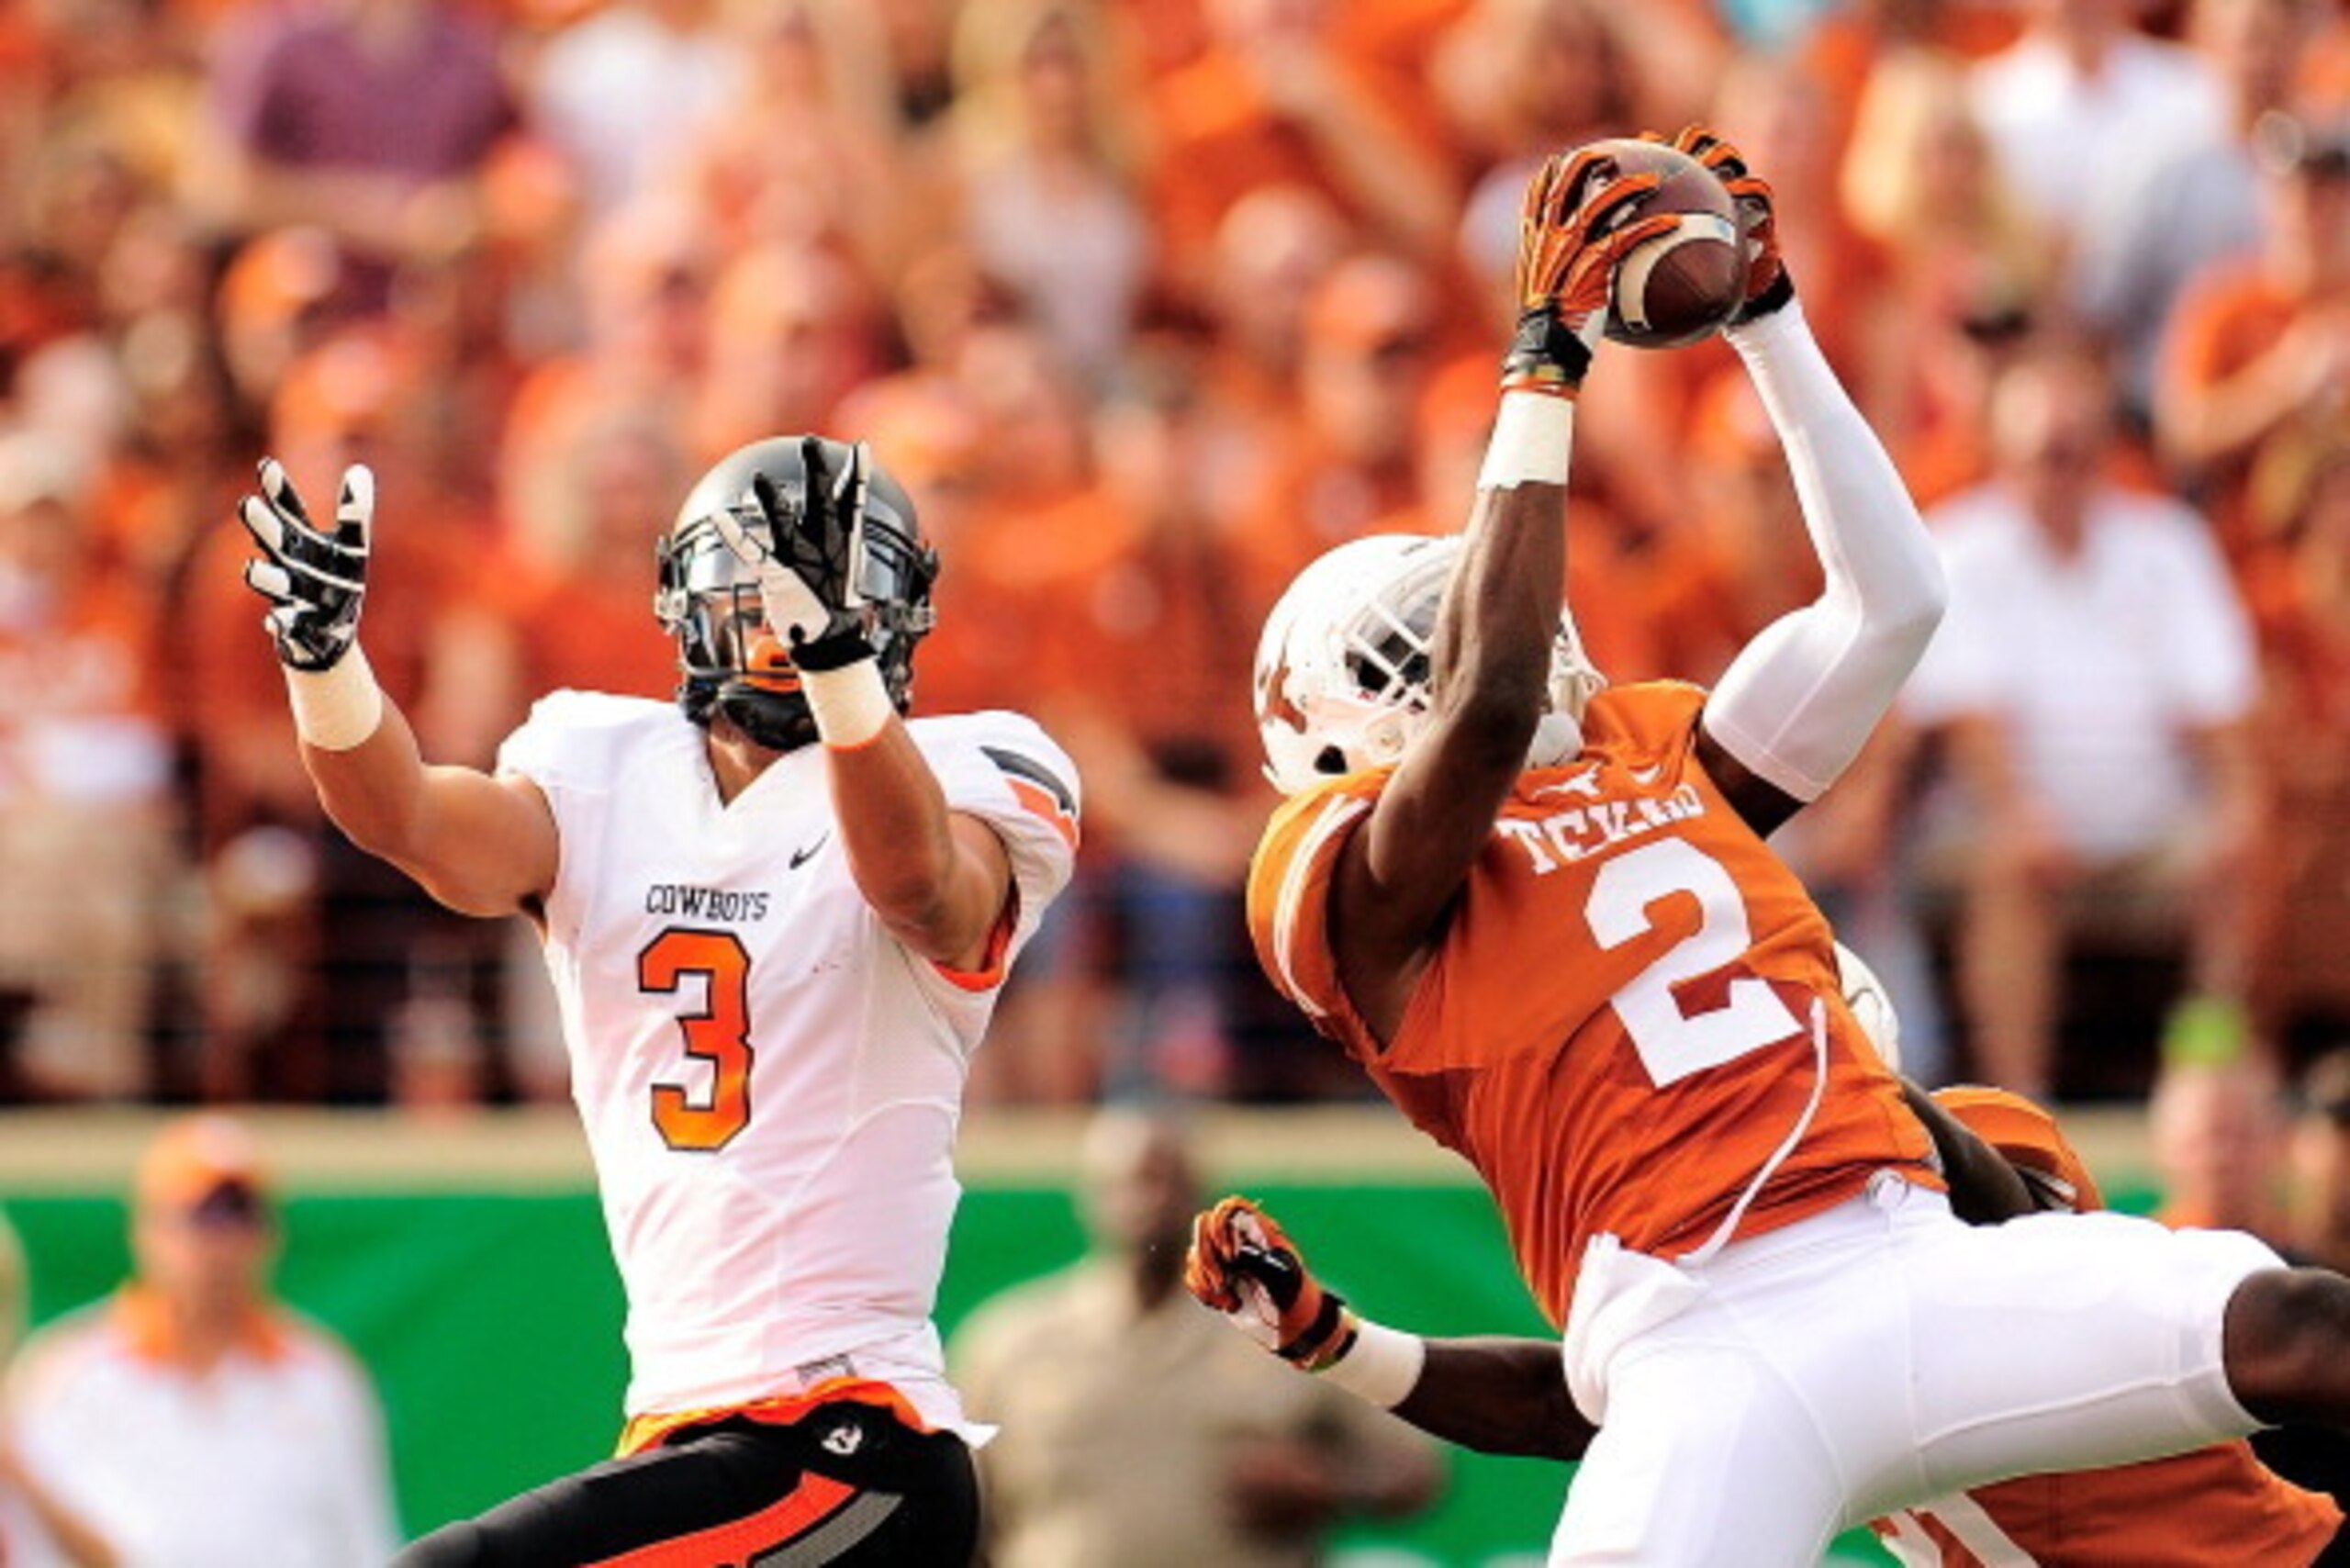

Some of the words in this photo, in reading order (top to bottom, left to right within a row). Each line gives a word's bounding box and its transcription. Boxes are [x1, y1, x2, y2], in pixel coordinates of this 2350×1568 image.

[645, 883, 770, 922] COWBOYS
[1583, 836, 1807, 1089] 2
[636, 925, 755, 1153] 3
